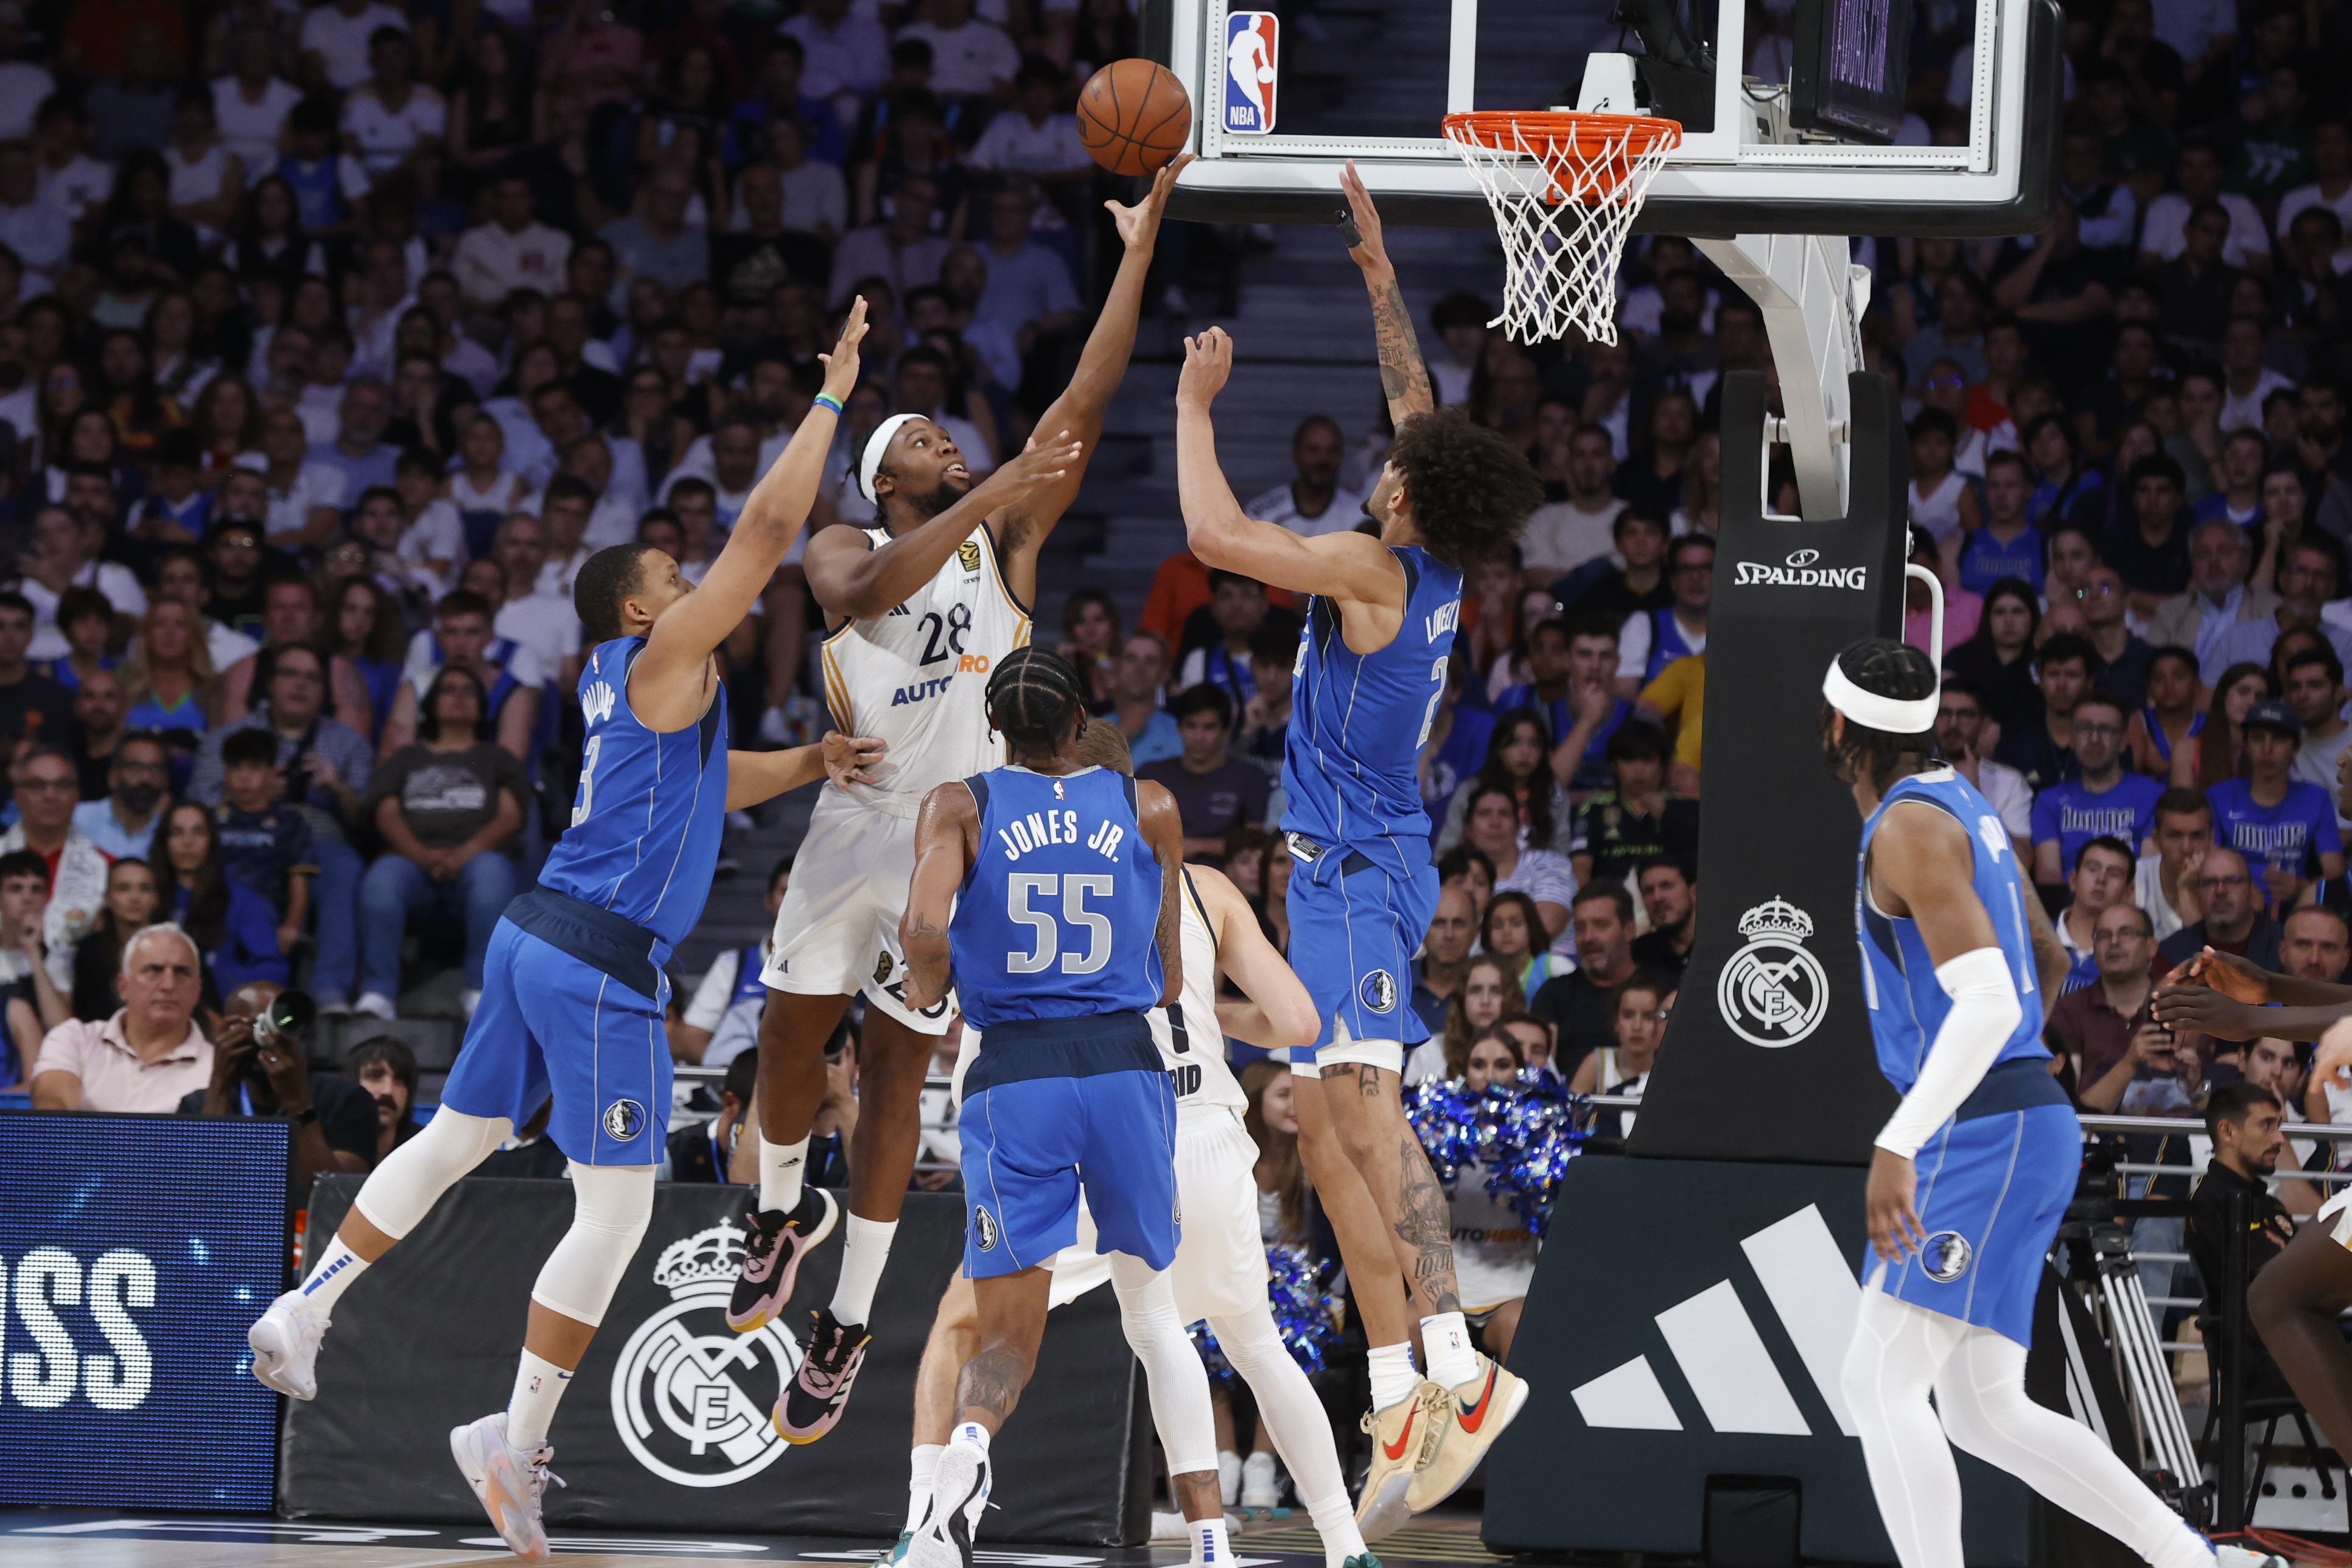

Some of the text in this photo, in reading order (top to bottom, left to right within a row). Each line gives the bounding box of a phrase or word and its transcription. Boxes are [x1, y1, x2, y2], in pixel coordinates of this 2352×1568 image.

[1230, 106, 1255, 125] NBA
[1734, 561, 1866, 590] SPALDING
[917, 603, 972, 667] 28
[1416, 655, 1449, 751] 2
[571, 735, 601, 828] 3
[998, 809, 1124, 863] JONES JR.
[1007, 872, 1113, 975] 55
[0, 1246, 156, 1412] SS
